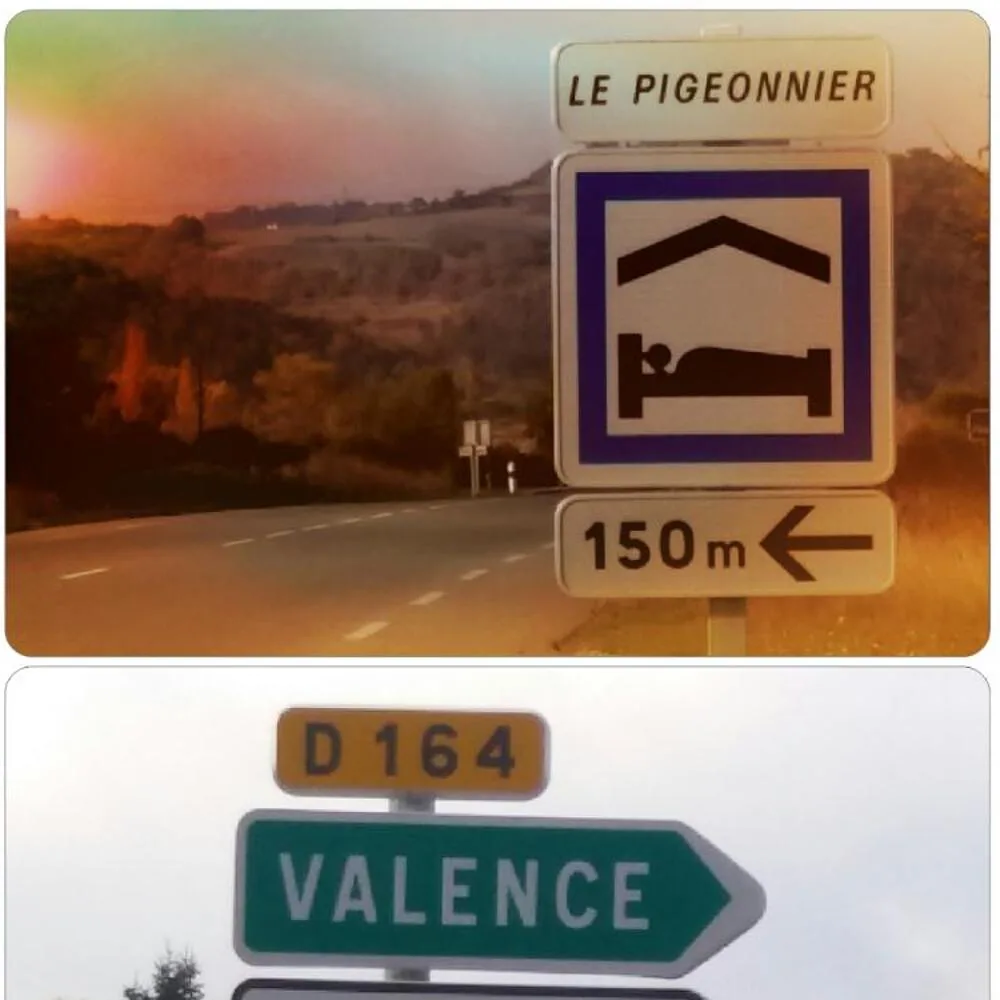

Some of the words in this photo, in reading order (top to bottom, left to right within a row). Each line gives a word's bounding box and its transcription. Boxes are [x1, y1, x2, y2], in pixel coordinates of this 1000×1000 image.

[568, 75, 611, 107] LE
[632, 70, 876, 105] PIGEONNIER
[304, 723, 342, 777] D
[375, 724, 516, 779] 164
[278, 852, 650, 931] VALENCE
